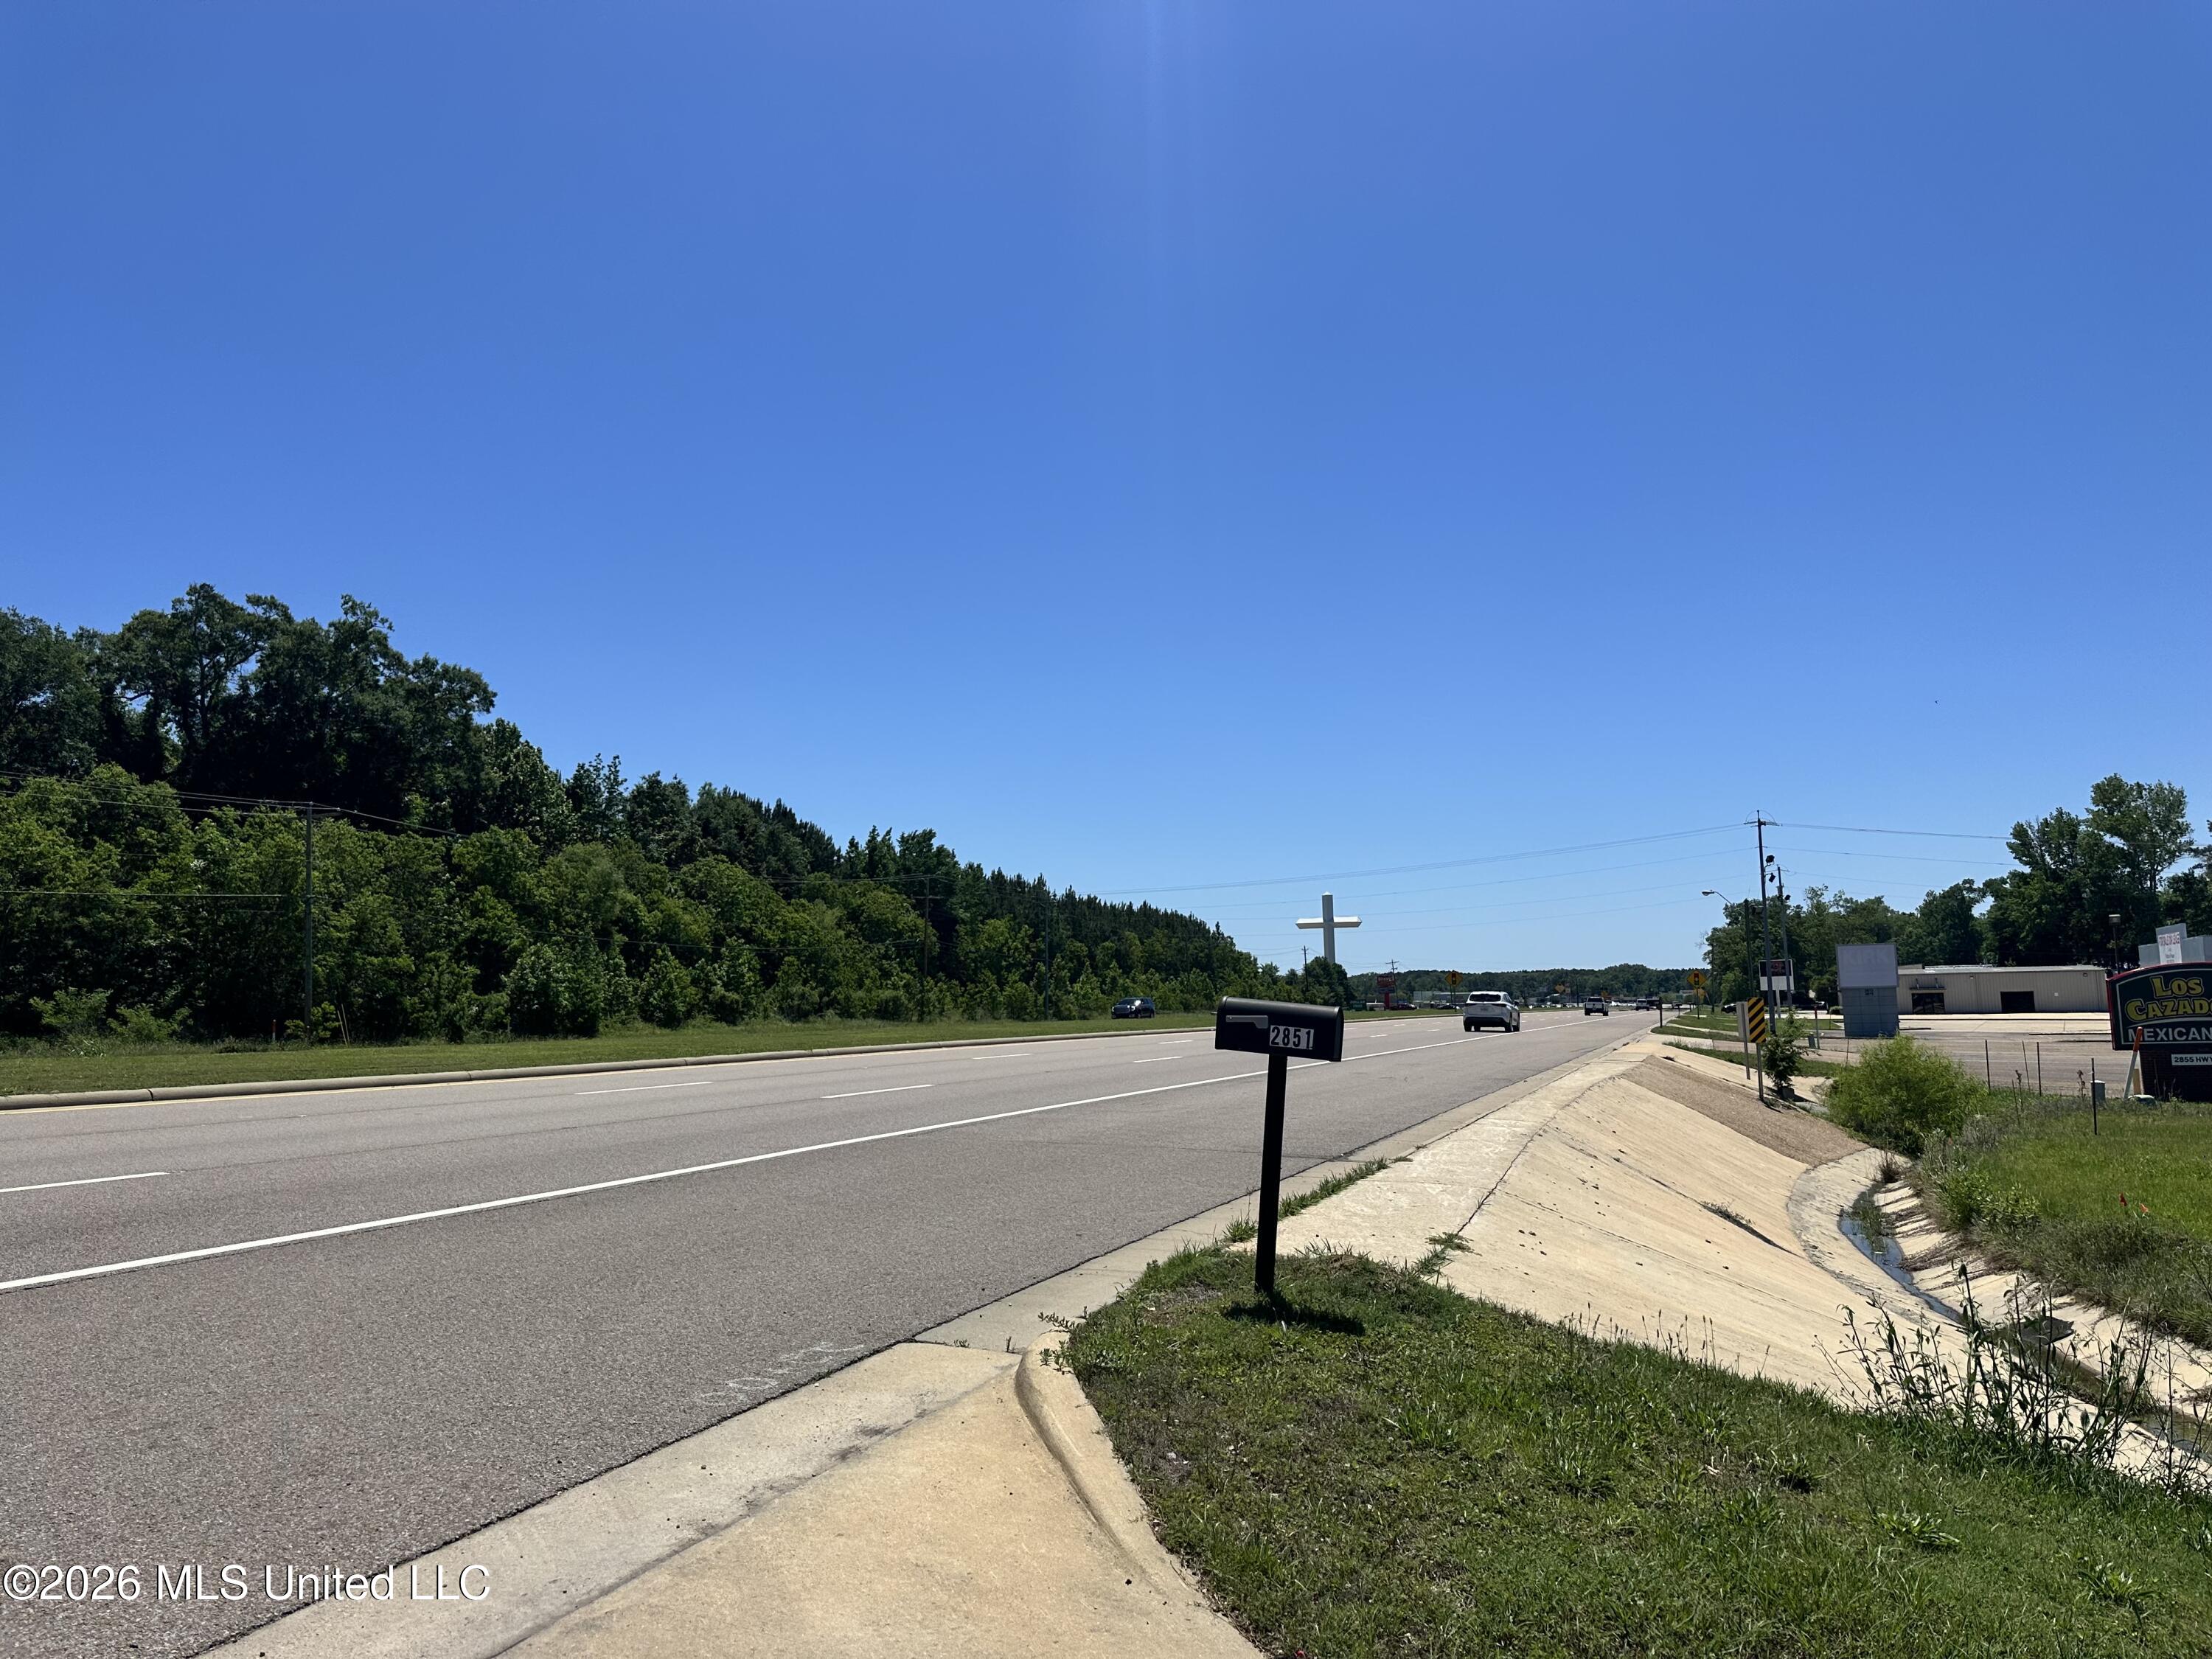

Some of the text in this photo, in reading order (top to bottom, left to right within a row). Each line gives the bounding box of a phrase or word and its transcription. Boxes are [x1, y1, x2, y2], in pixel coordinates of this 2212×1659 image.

[2151, 976, 2203, 998] LOS
[2125, 998, 2212, 1021] CAZAD
[1271, 1026, 1312, 1048] 2851
